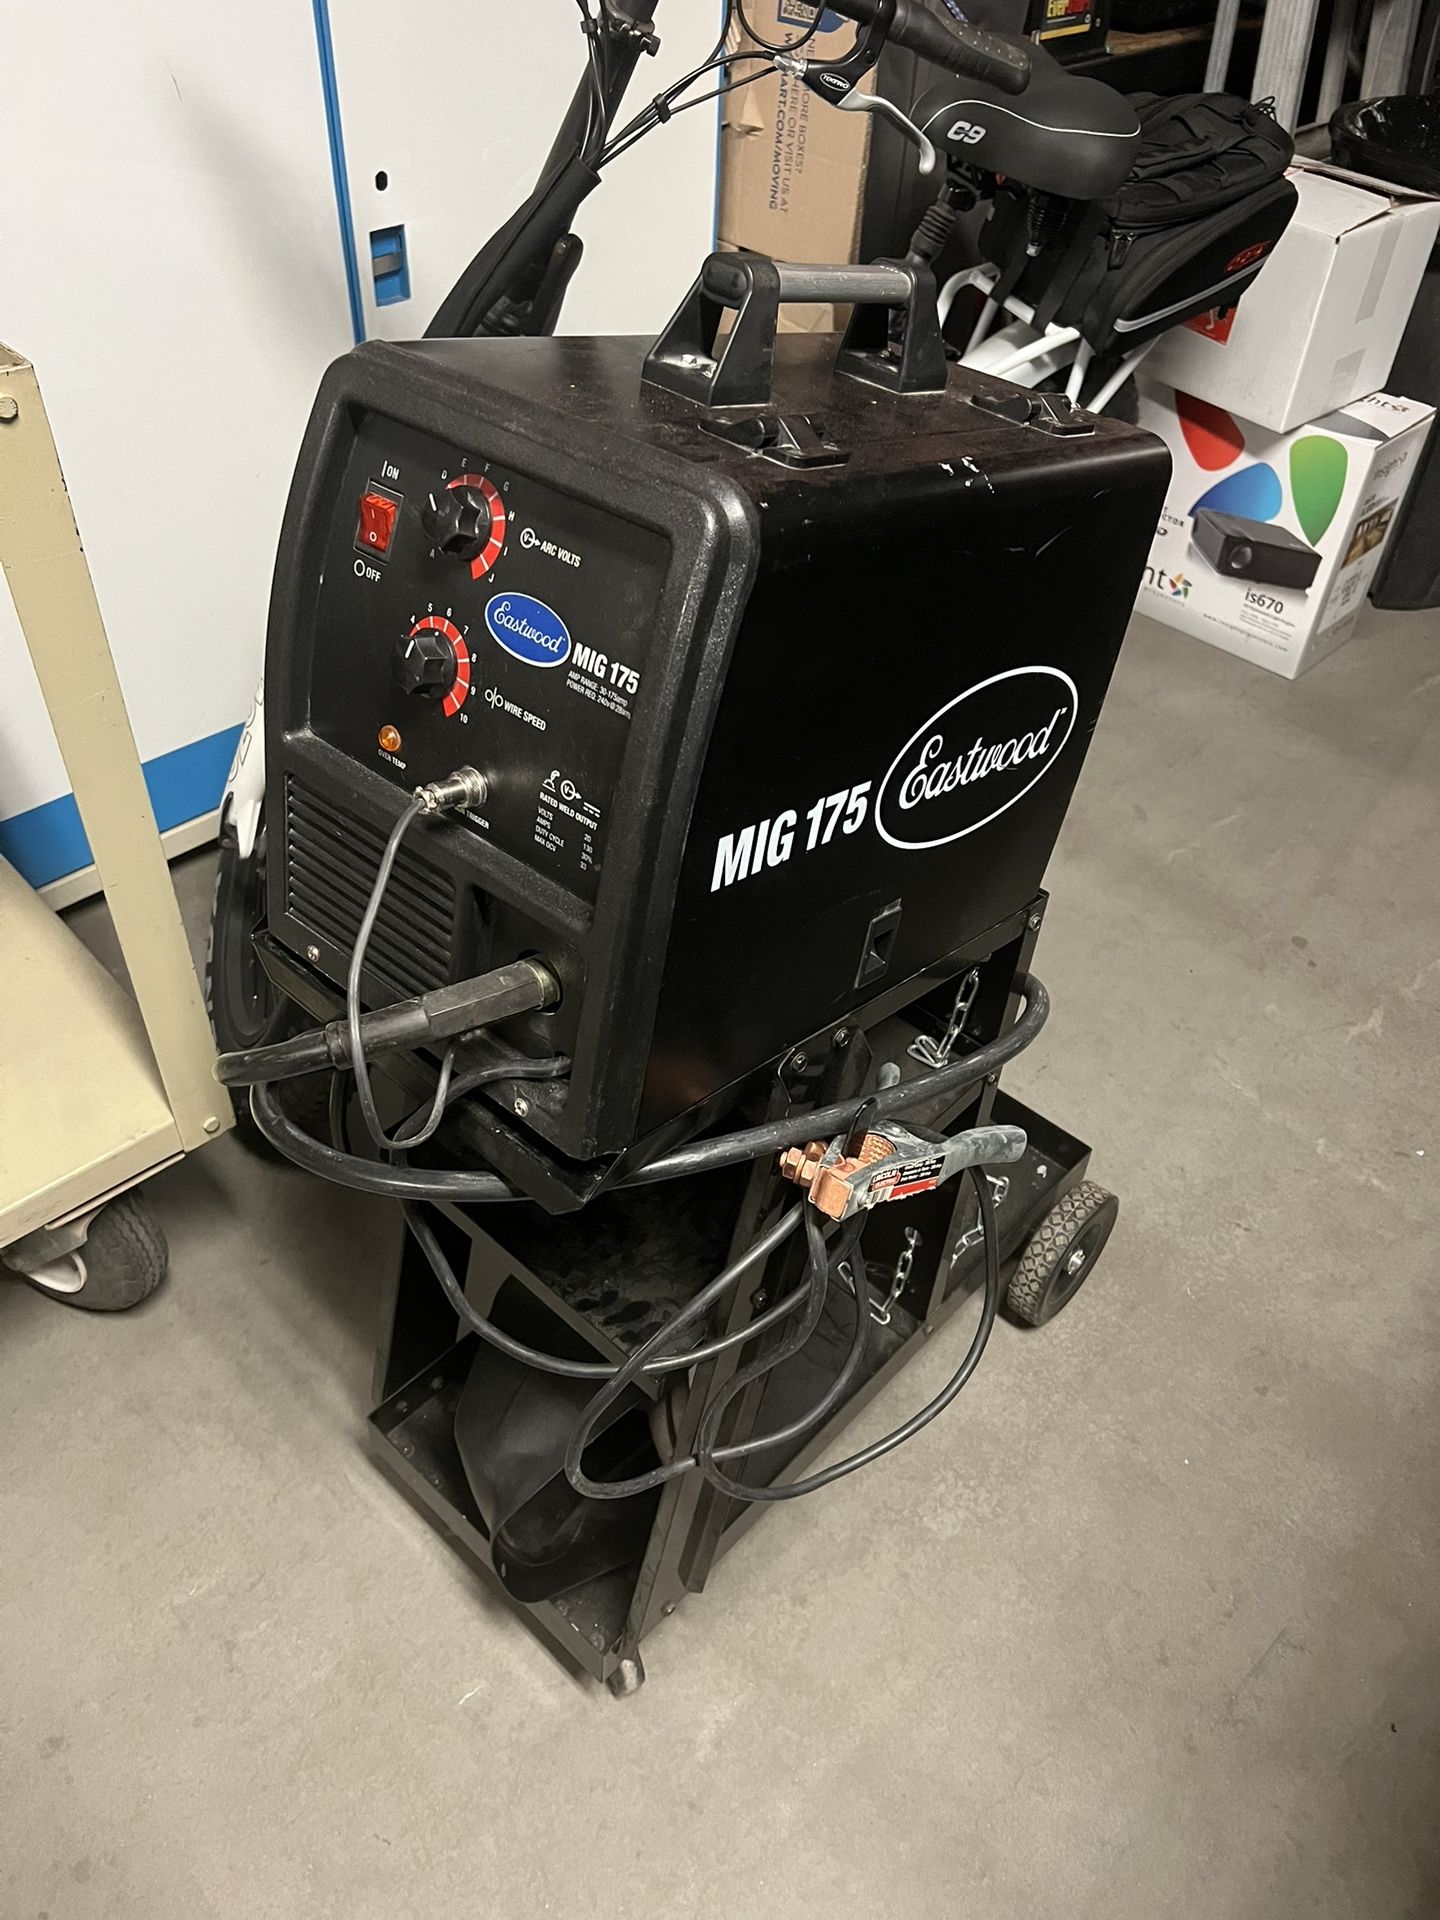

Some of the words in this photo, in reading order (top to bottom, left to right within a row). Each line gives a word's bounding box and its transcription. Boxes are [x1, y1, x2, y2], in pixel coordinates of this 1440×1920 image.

[787, 116, 797, 139] OR
[946, 120, 987, 144] C9
[794, 124, 808, 175] BOXES?
[783, 142, 795, 175] VISIT
[781, 177, 791, 195] US
[780, 197, 790, 215] AT
[461, 457, 468, 468] E
[484, 463, 491, 472] F
[386, 466, 400, 480] ON
[441, 470, 448, 480] D
[508, 510, 516, 522] H
[540, 540, 557, 557] ARC
[556, 547, 582, 568] VOLTS
[365, 568, 381, 582] OFF
[488, 573, 495, 583] J
[427, 602, 434, 613] 5
[1245, 586, 1284, 614] is670
[410, 615, 416, 624] 4
[446, 607, 453, 617] 6
[463, 625, 469, 635] 7
[493, 600, 564, 653] Eastwood
[471, 652, 478, 662] 8
[571, 642, 608, 679] MIG
[610, 662, 641, 694] 175
[470, 686, 476, 695] 9
[566, 678, 585, 694] POWER
[460, 713, 468, 724] 10
[504, 699, 523, 719] WIRE
[523, 710, 547, 731] SPEED
[377, 748, 392, 762] OVER
[392, 756, 407, 770] TEMP
[899, 707, 1062, 810] Eastwood
[538, 806, 553, 821] VOLTS
[539, 791, 559, 808] RATED
[558, 802, 575, 818] WELD
[575, 812, 598, 831] OUTPUT
[710, 809, 798, 893] MIG
[805, 780, 872, 851] 175
